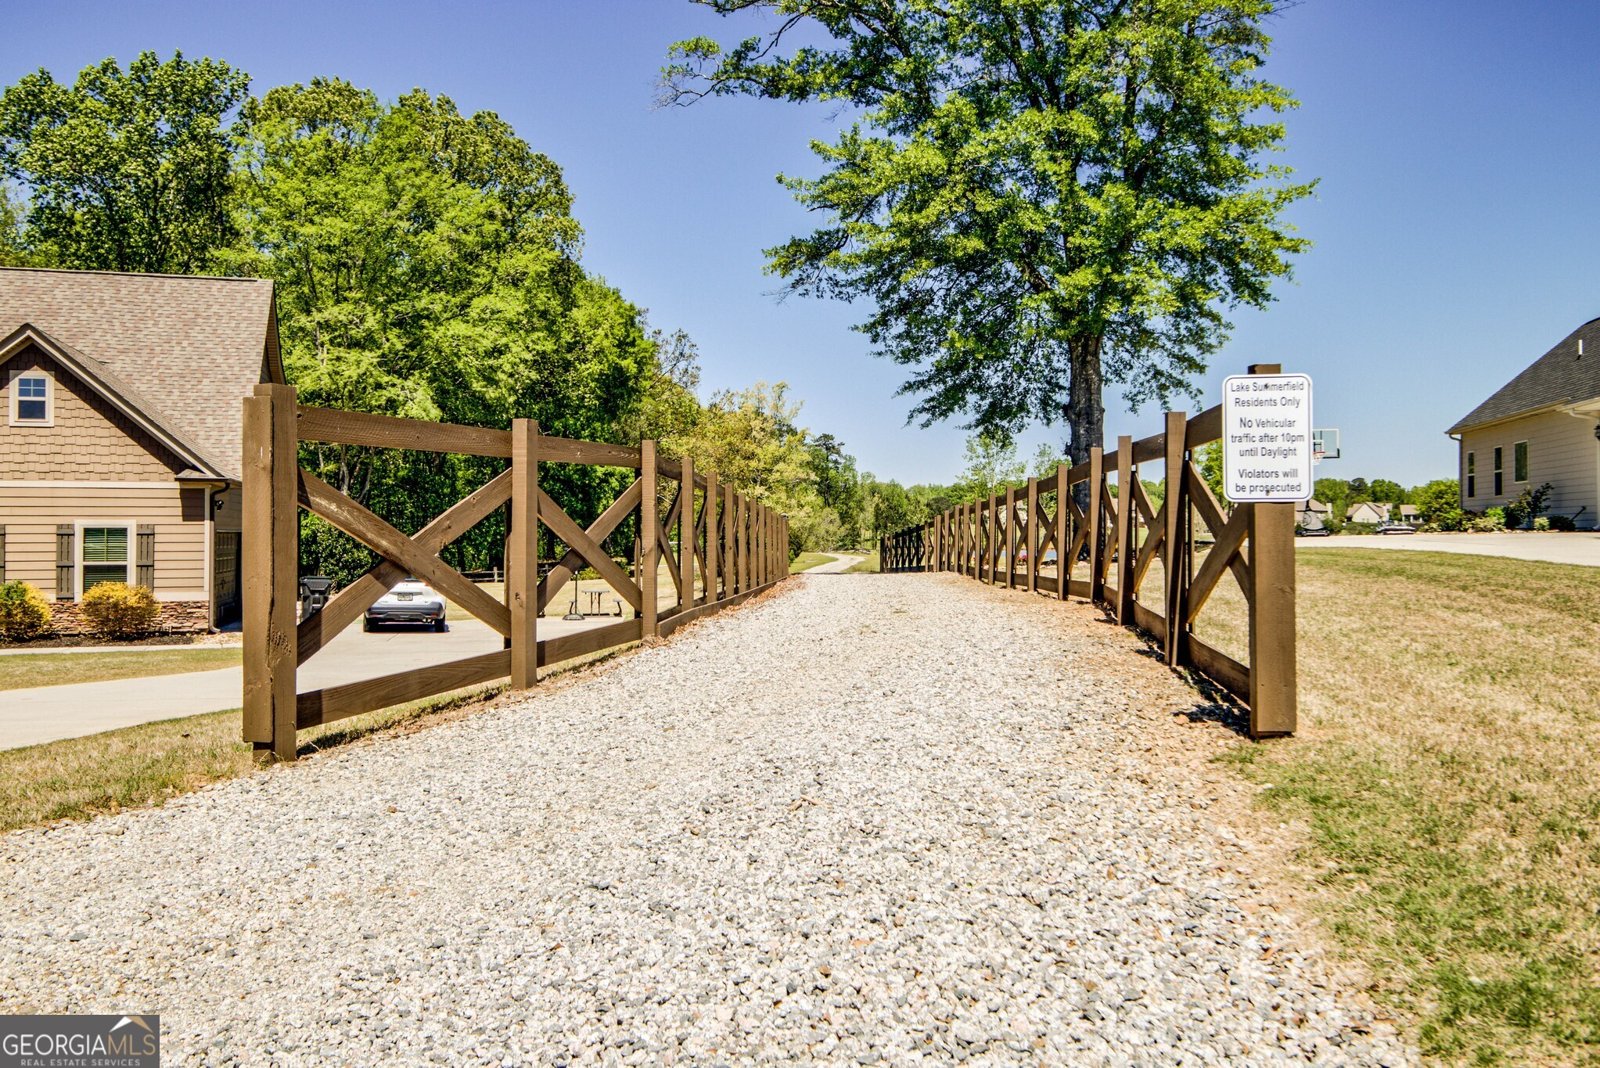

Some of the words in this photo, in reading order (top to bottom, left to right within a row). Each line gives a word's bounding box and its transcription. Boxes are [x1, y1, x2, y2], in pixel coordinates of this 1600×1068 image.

[1231, 382, 1250, 392] Lake
[1252, 381, 1304, 392] Summerfield
[1234, 397, 1277, 407] Residents
[1280, 396, 1301, 408] Only
[1239, 417, 1253, 428] No
[1255, 418, 1296, 428] Vehicular
[1231, 433, 1256, 443] traffic
[1258, 433, 1278, 442] after
[1281, 432, 1305, 444] 10pm
[1239, 447, 1258, 457] until
[1261, 447, 1297, 459] Daylight
[1238, 469, 1279, 478] Violators
[1282, 468, 1298, 478] will
[1235, 483, 1246, 492] be
[1249, 482, 1301, 494] prosecuted
